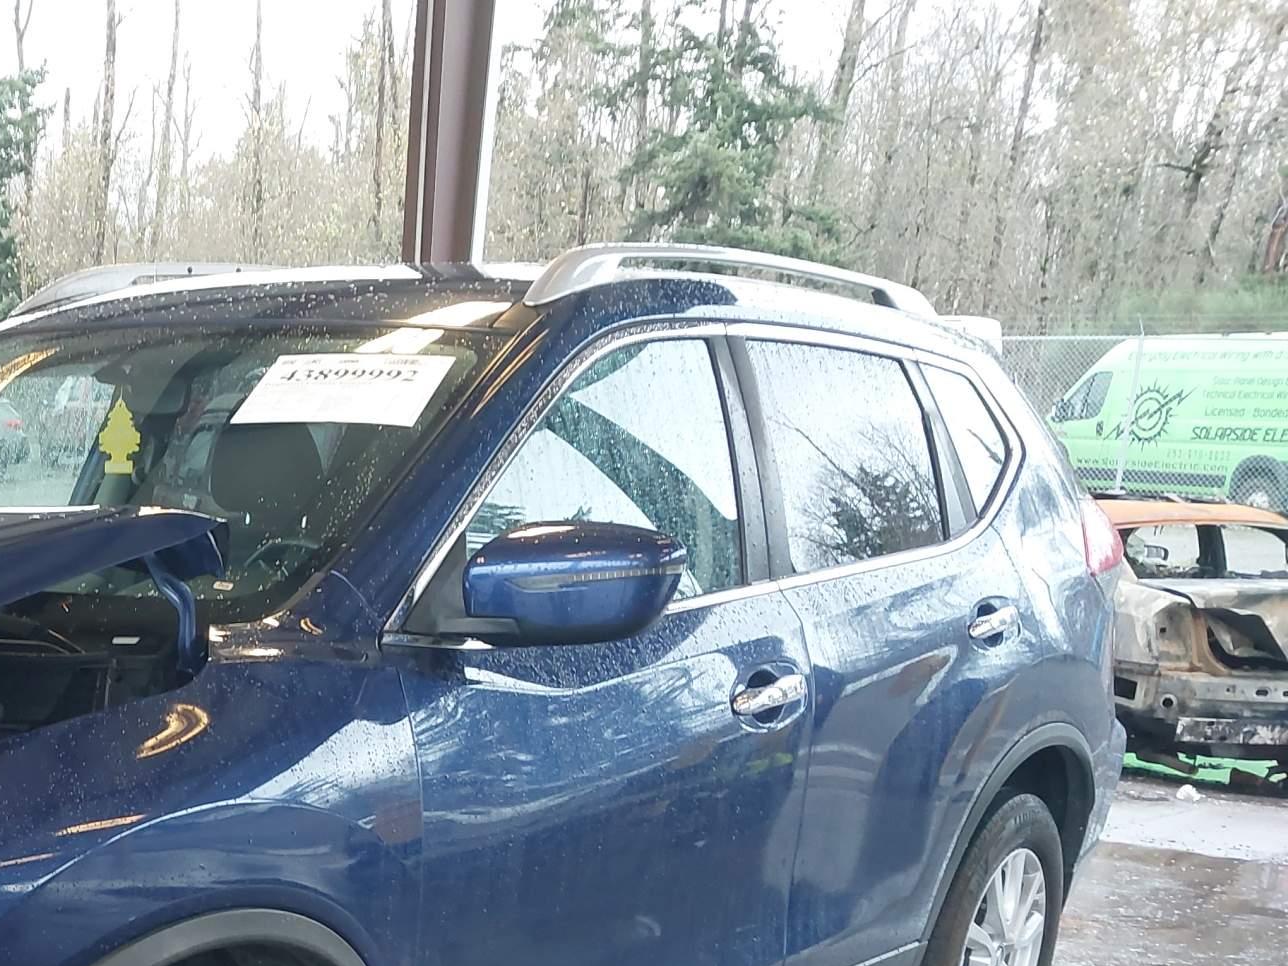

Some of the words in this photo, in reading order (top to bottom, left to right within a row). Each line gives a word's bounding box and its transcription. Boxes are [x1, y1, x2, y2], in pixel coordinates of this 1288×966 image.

[280, 368, 418, 382] 43899992
[1204, 405, 1246, 417] Licensed
[1190, 426, 1262, 442] SOLARSIDE
[1076, 456, 1229, 473] www.SolrsideElectric.com
